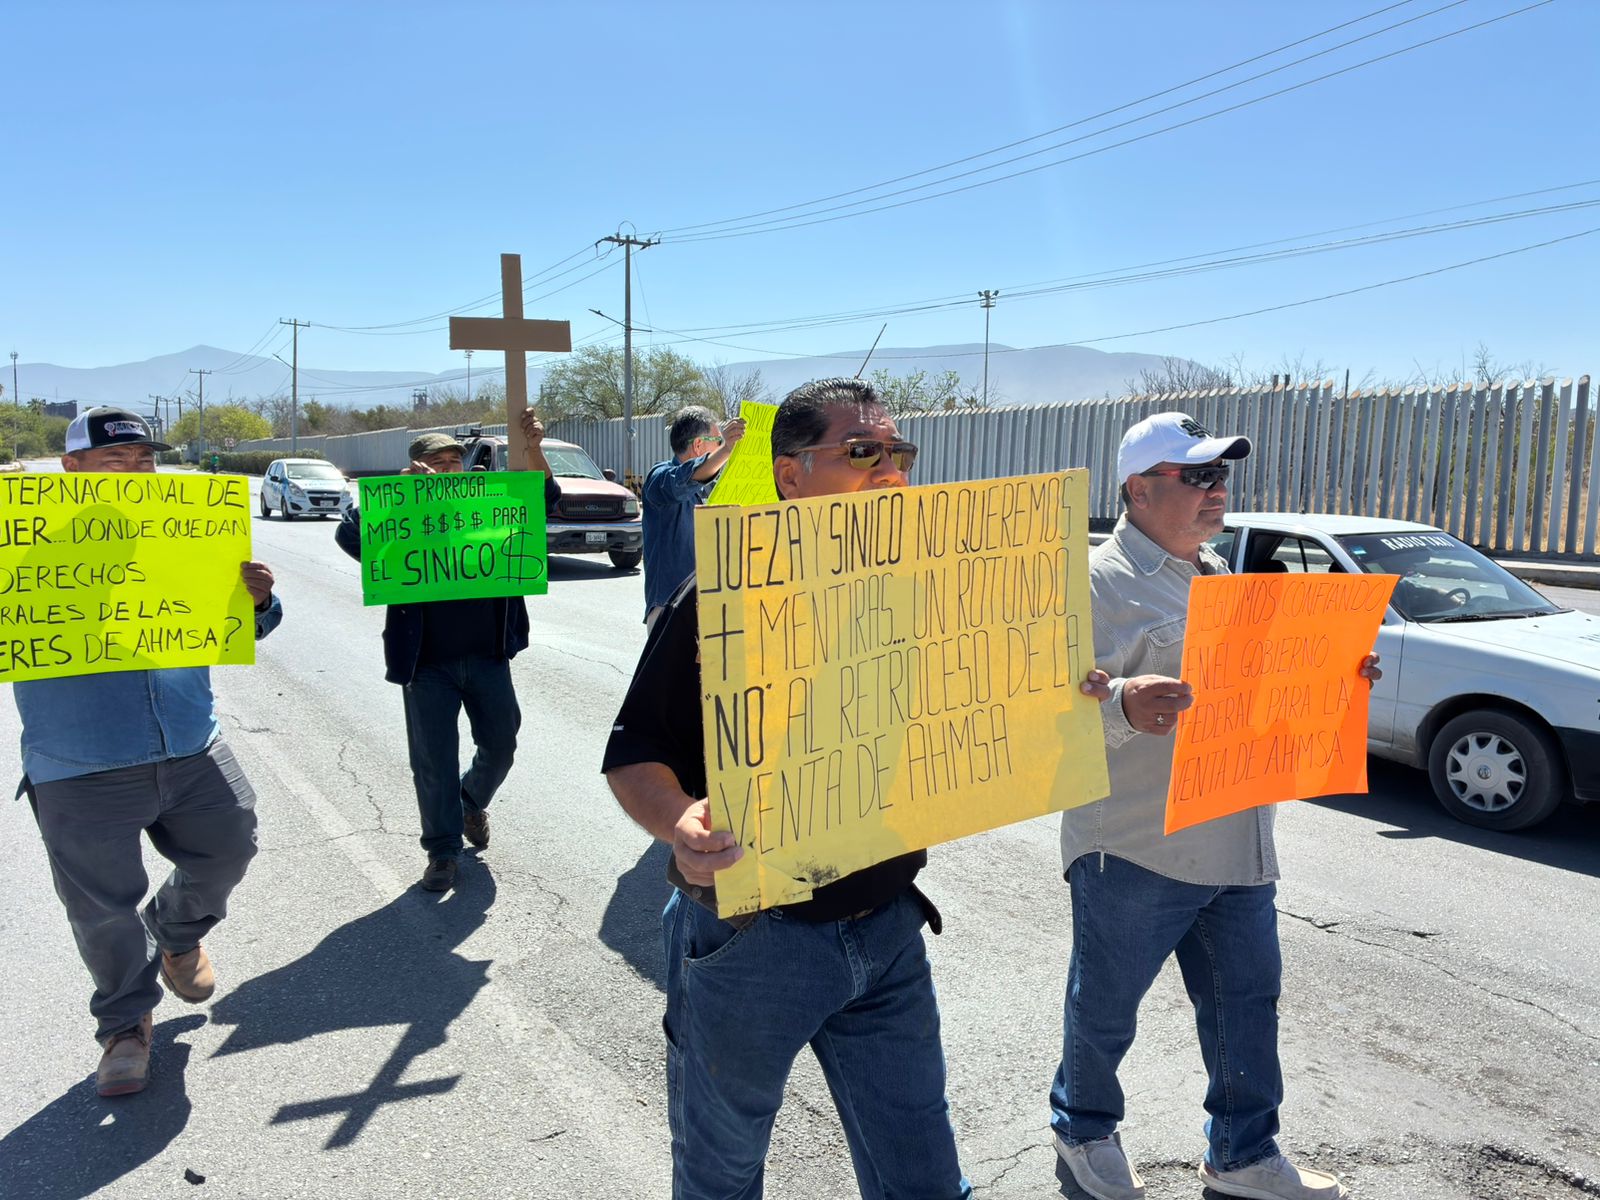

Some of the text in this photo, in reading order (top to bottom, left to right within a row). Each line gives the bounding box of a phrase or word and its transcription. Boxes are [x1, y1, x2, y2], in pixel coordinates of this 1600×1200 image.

[3, 476, 244, 508] TERNACIONAL DE
[364, 483, 405, 511] MAS
[72, 517, 157, 544] DONDE
[163, 517, 247, 538] QUEDAN
[368, 518, 411, 544] MAS
[493, 505, 527, 526] PARA
[700, 476, 1073, 594] JUEZA Y SINICO NO QUEREMOS
[1380, 536, 1426, 551] RADIO
[0, 562, 145, 594] DERECHOS
[371, 560, 392, 582] EL
[1, 599, 191, 625] RALES DE LAS
[913, 568, 946, 640] UN
[958, 547, 1069, 631] ROTUNDO
[1188, 579, 1386, 635] SEGUIMOS CONFIANDO
[85, 632, 122, 663] DE
[133, 616, 243, 657] AHMSA?
[1241, 634, 1330, 678] GOBIERNO
[788, 677, 824, 757] AL
[840, 630, 990, 743] RETROCESO
[1008, 622, 1042, 698] DE
[1054, 614, 1080, 688] LA
[1266, 682, 1311, 724] PARA
[1324, 677, 1351, 715] LA
[719, 703, 1012, 854] VENTA DE AHMSA
[1173, 730, 1344, 804] VENTA DE AHMSA
